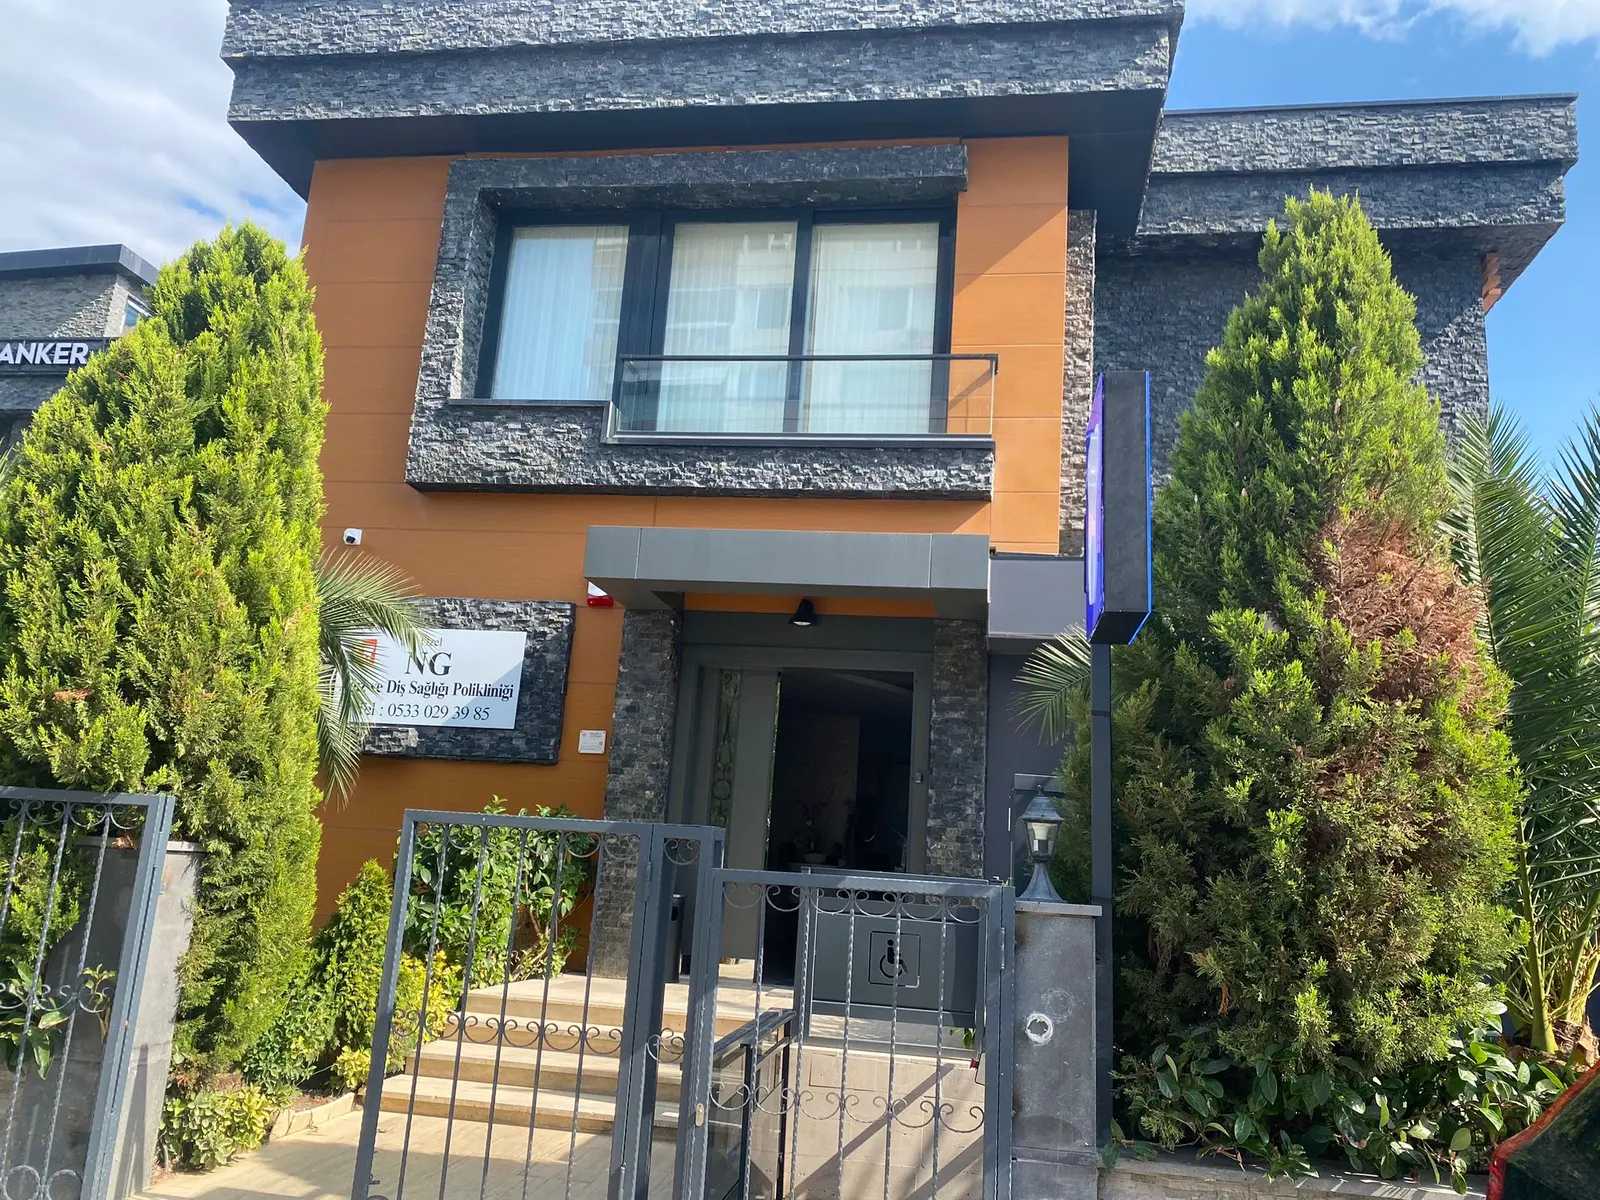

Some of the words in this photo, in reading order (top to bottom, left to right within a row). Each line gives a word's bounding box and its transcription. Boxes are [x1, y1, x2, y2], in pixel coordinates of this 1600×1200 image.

[0, 342, 89, 365] ANKER
[404, 651, 452, 676] NG
[387, 680, 406, 697] Diş
[409, 680, 449, 699] Sağlığı
[453, 682, 514, 702] Polikliniği
[387, 703, 419, 718] 0533
[424, 704, 449, 719] 029
[452, 706, 470, 720] 39
[473, 706, 491, 721] 85
